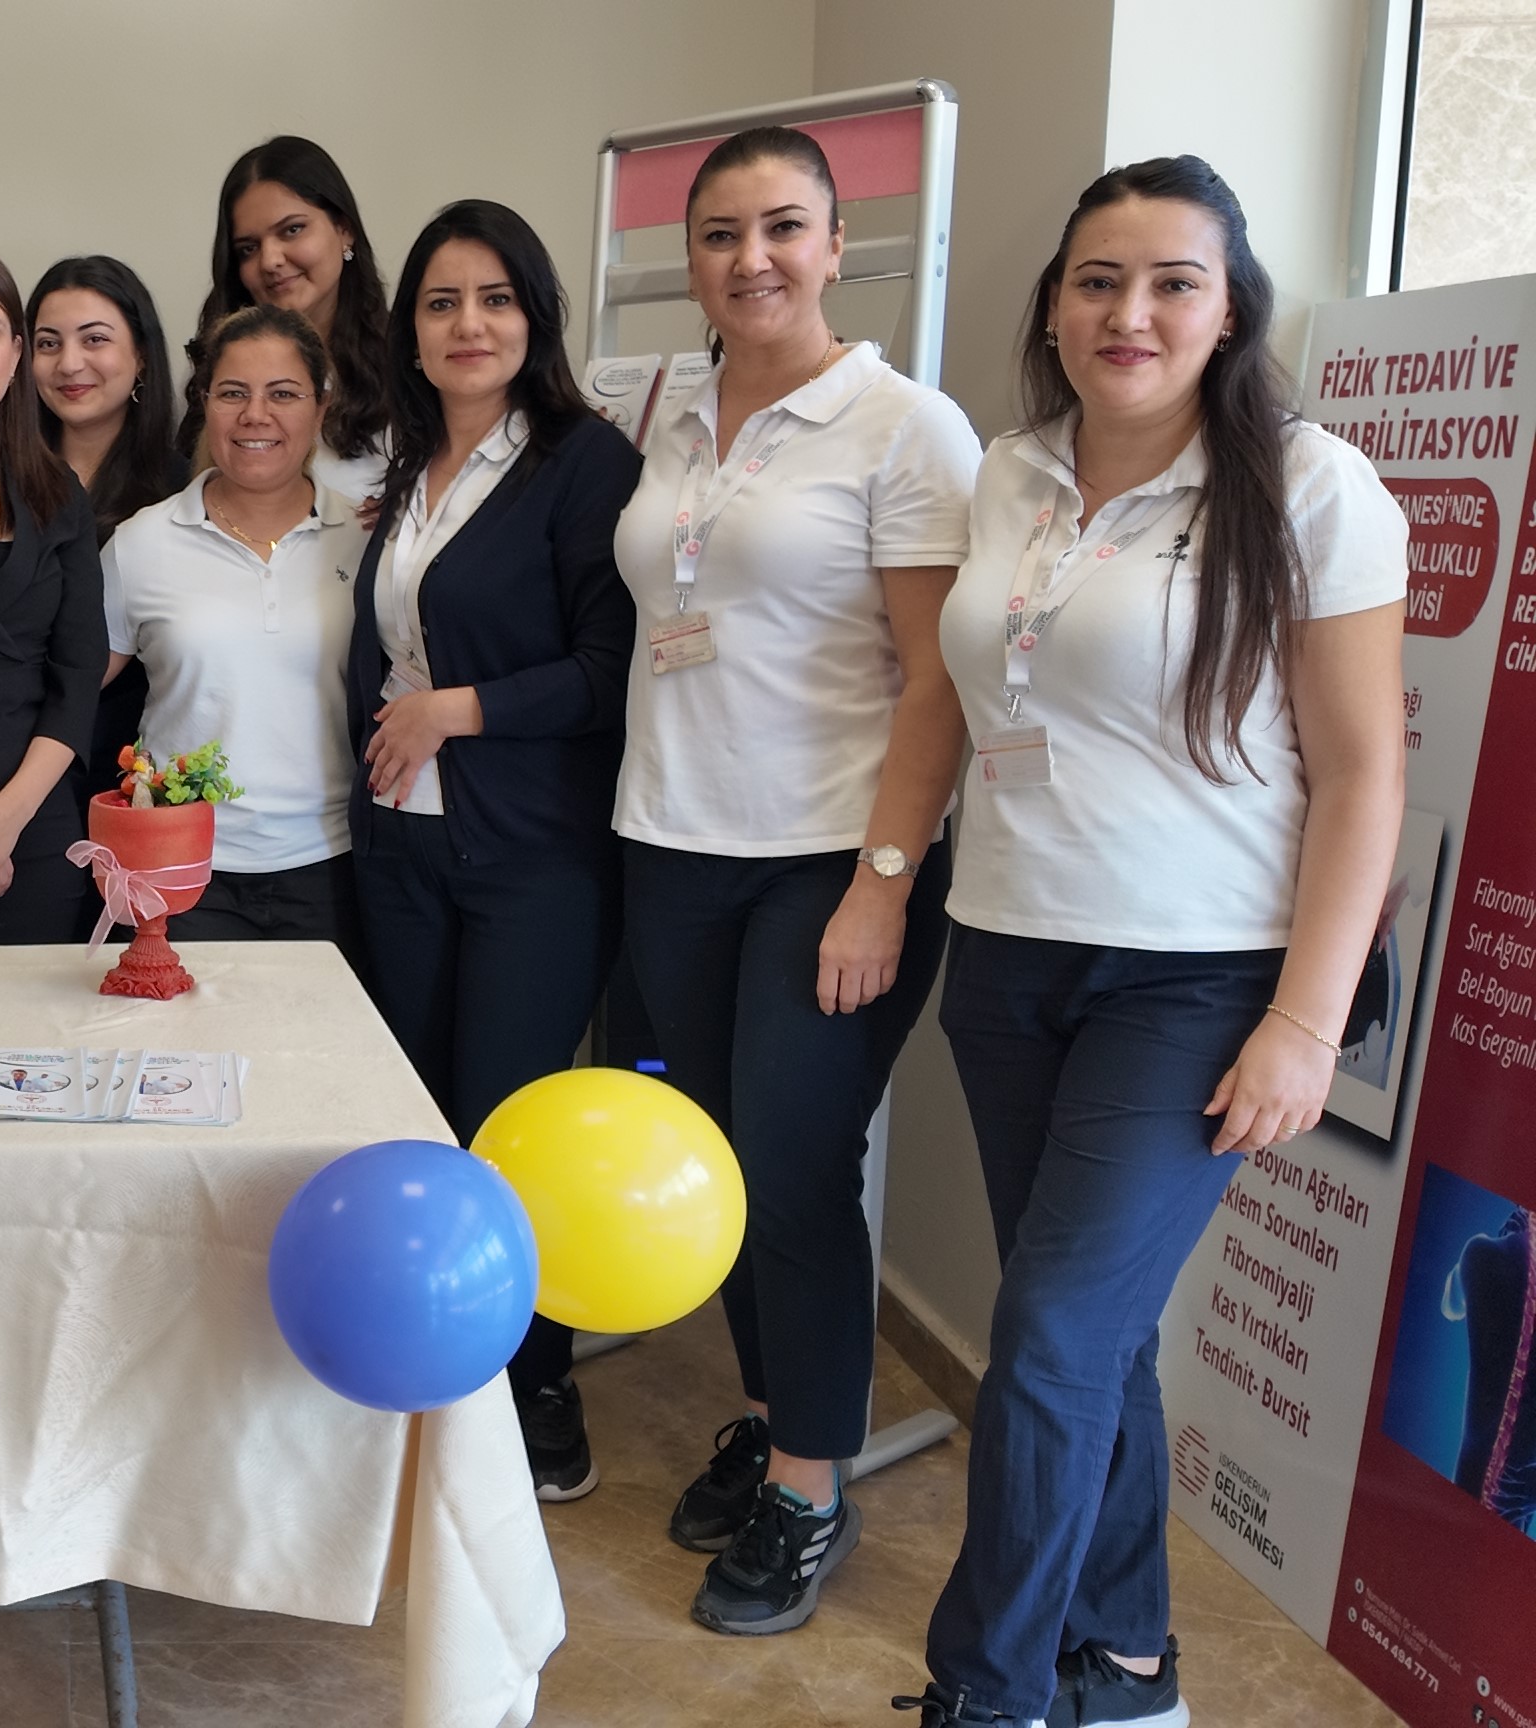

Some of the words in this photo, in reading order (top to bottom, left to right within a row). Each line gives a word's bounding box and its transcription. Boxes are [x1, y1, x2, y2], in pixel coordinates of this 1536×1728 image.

[1320, 347, 1378, 399] FİZİK
[1385, 335, 1478, 395] TEDAVİ
[1484, 343, 1519, 389] VE
[1407, 541, 1481, 578] NLUKLU
[1407, 582, 1444, 621] VİSİ
[1473, 877, 1536, 928] Fibromiy
[1465, 922, 1493, 956] Sırt
[1458, 967, 1533, 1018] Bel-Boyun
[1450, 1012, 1477, 1046] Kas
[1254, 1146, 1303, 1191] Boyun
[1305, 1167, 1369, 1228] Ağrıları
[1221, 1181, 1262, 1226] klem
[1264, 1202, 1339, 1272] Sorunları
[1223, 1234, 1315, 1323] Fibromiyalji
[1211, 1283, 1237, 1324] Kas
[1242, 1302, 1308, 1375] Yırtıkları
[1261, 1377, 1311, 1438] Bursit
[1211, 1493, 1284, 1571] HASTANESİ
[1361, 1618, 1389, 1650] 0544
[1390, 1644, 1413, 1670] 494
[1414, 1661, 1427, 1681] 77
